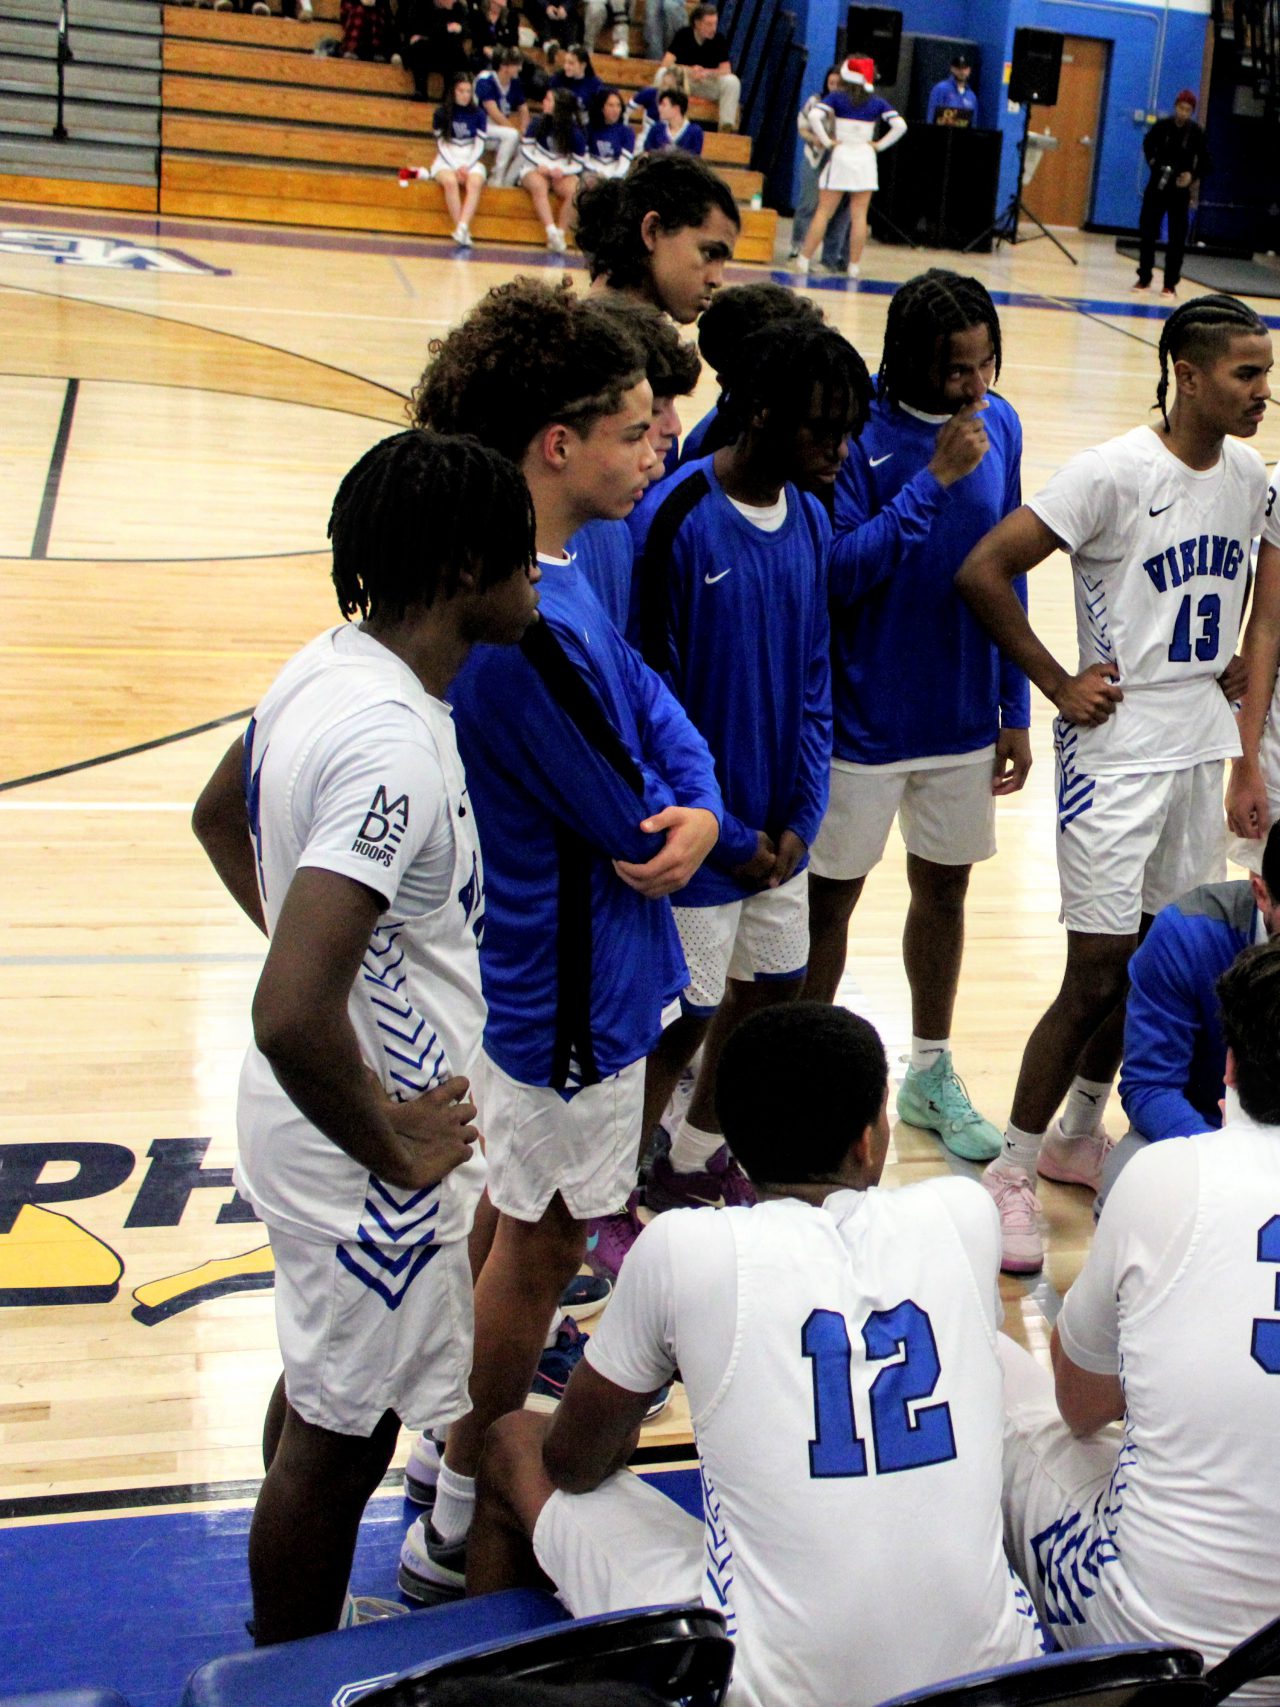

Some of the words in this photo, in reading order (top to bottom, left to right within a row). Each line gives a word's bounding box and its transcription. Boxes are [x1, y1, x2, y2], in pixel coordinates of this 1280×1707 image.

[1143, 534, 1244, 593] VIKING
[1168, 593, 1221, 662] 13
[351, 838, 394, 868] HOOPS
[800, 1299, 957, 1479] 12
